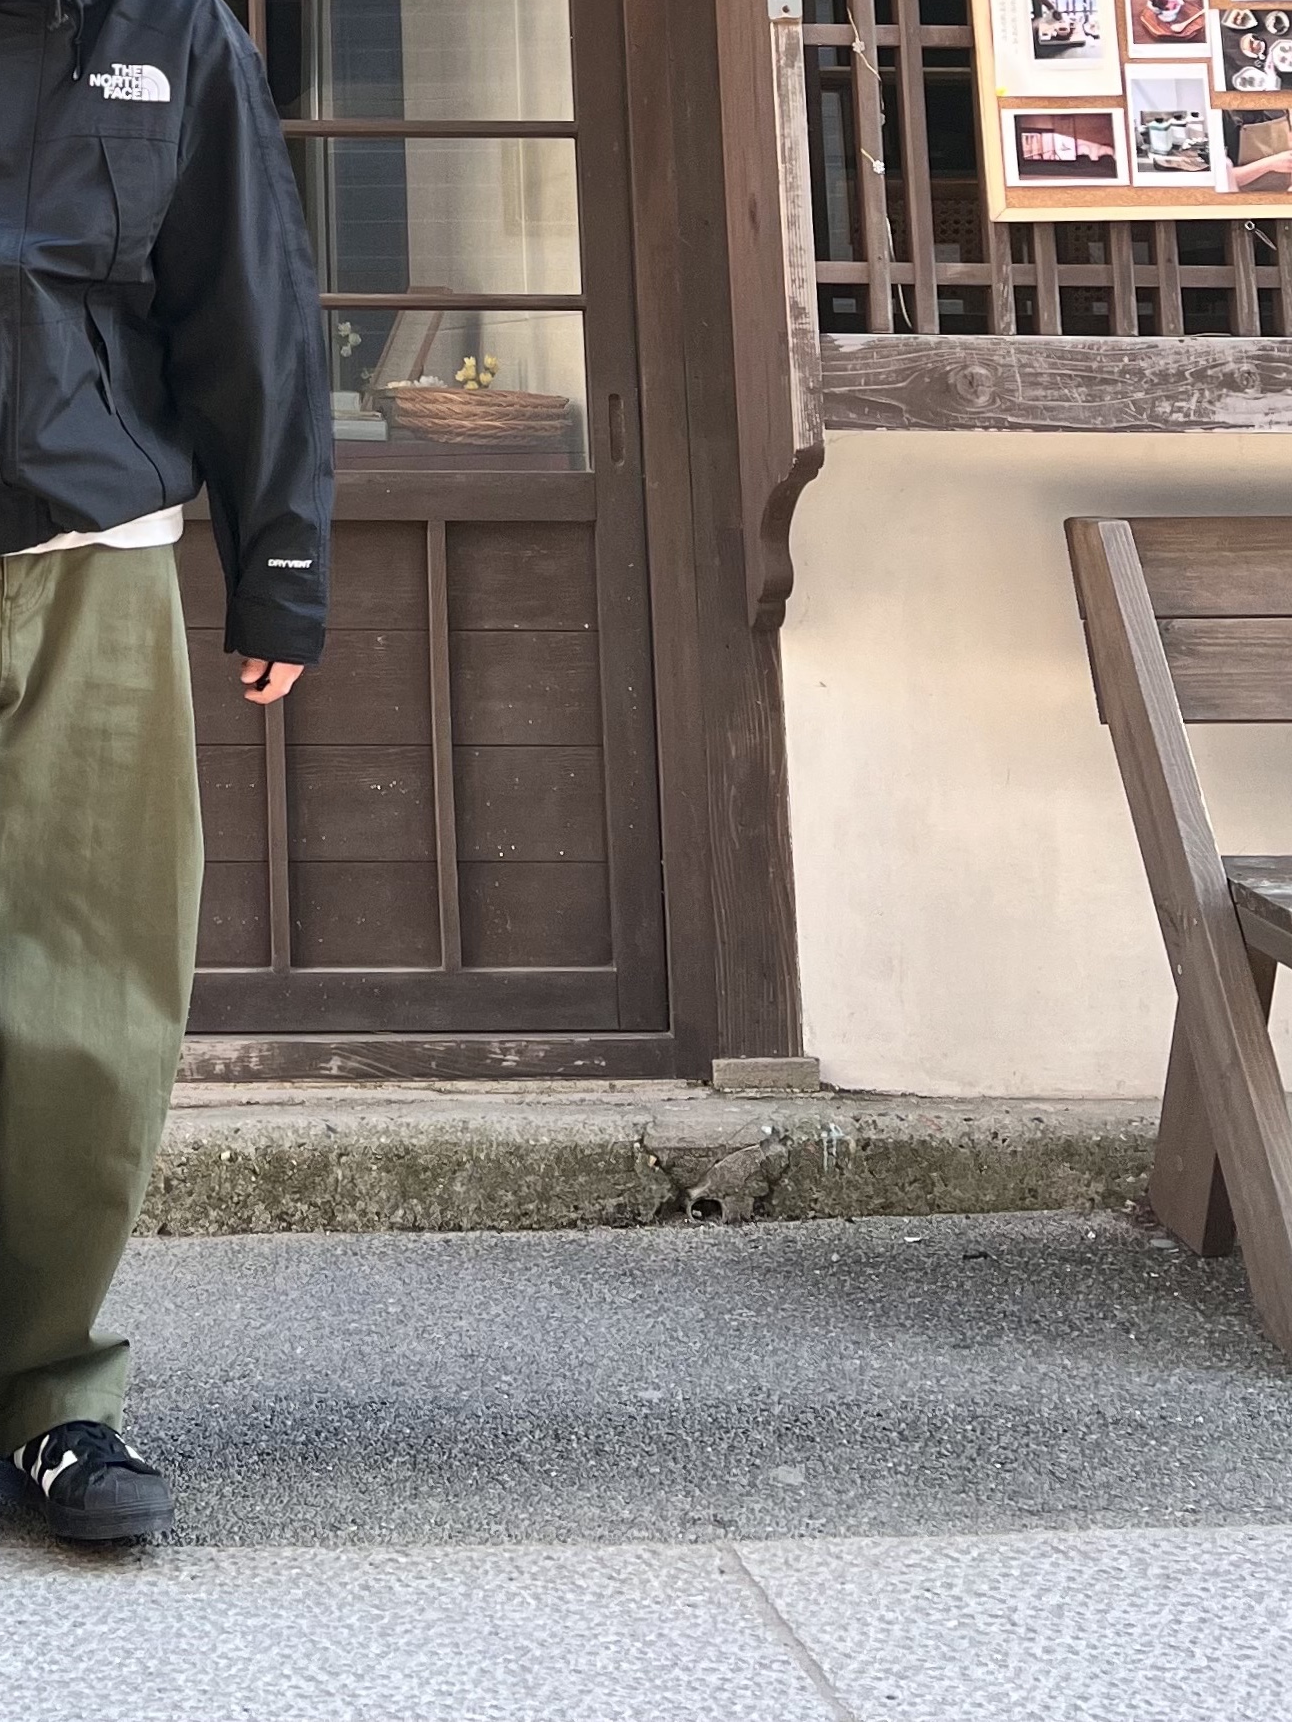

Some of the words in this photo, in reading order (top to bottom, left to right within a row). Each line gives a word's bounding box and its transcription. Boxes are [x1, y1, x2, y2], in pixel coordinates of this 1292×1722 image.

[111, 63, 142, 76] THE
[89, 73, 142, 89] NORTH
[103, 87, 142, 100] FACE
[268, 559, 313, 569] DRYVENT
